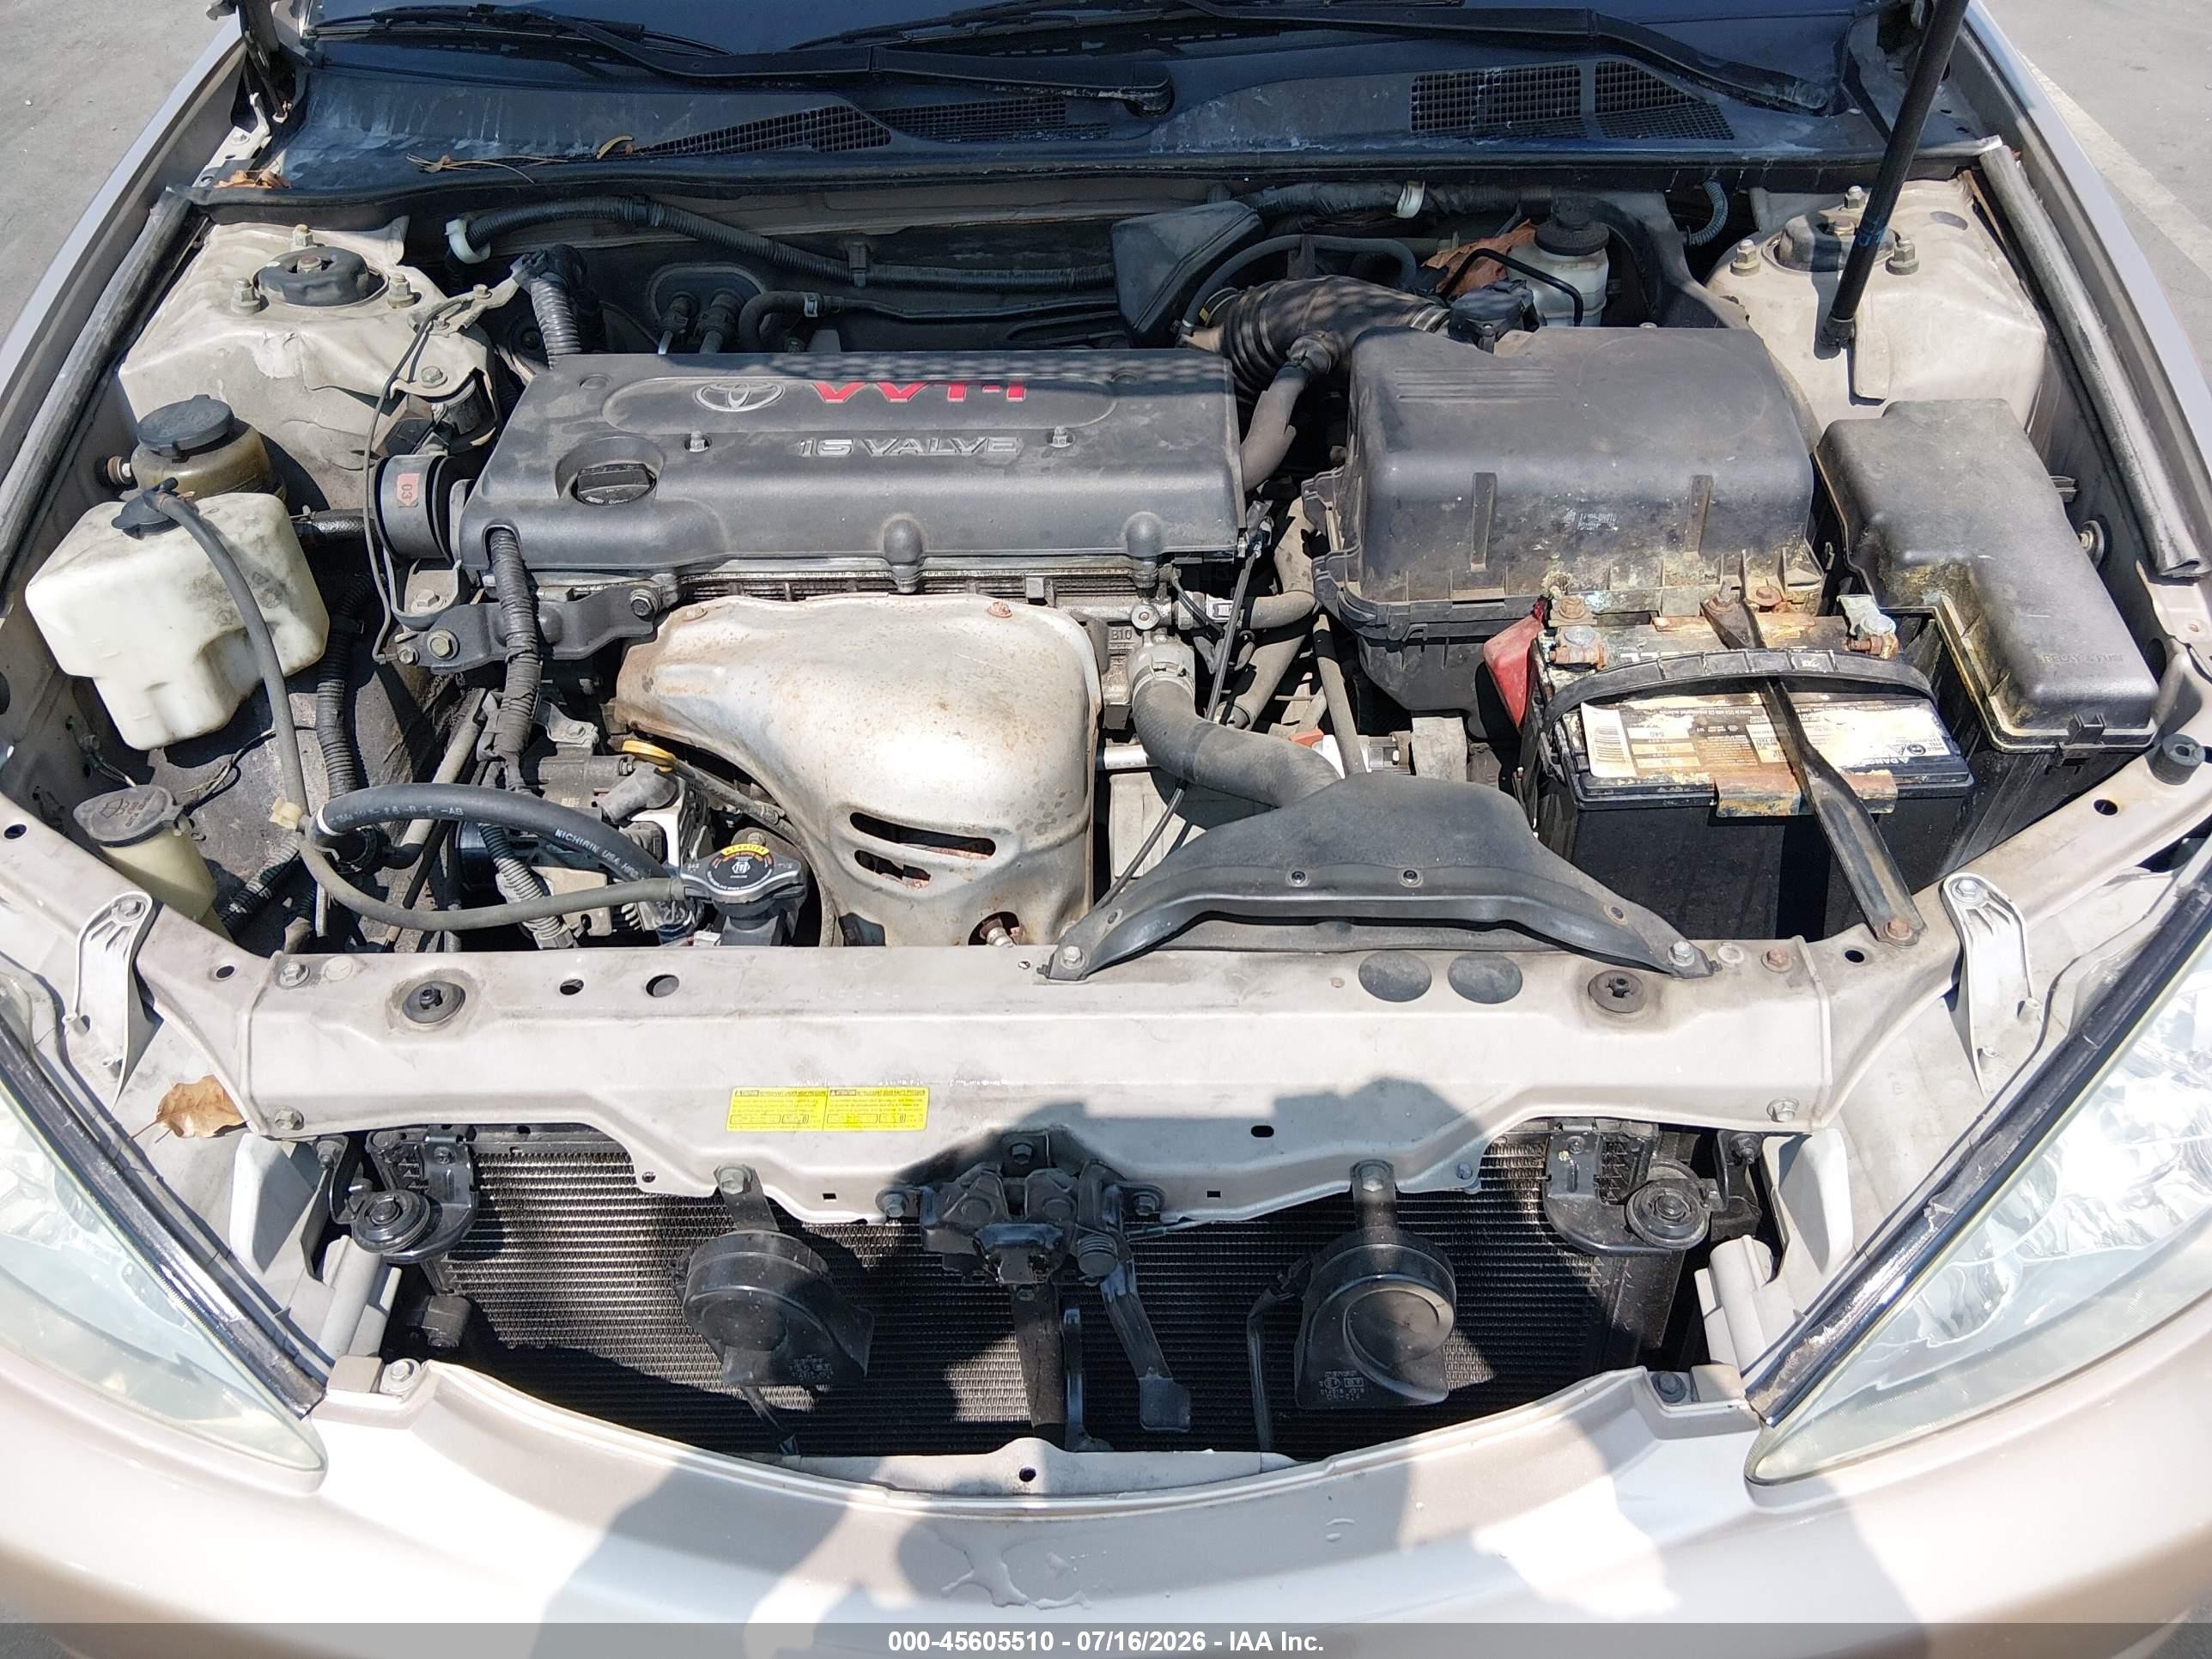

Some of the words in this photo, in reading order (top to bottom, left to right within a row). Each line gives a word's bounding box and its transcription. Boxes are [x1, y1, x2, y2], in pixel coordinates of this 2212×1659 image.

[799, 438, 854, 457] 16
[862, 436, 1023, 457] VALVE
[401, 483, 413, 500] 03
[554, 828, 600, 854] NICHIRIN
[601, 849, 621, 866] USA
